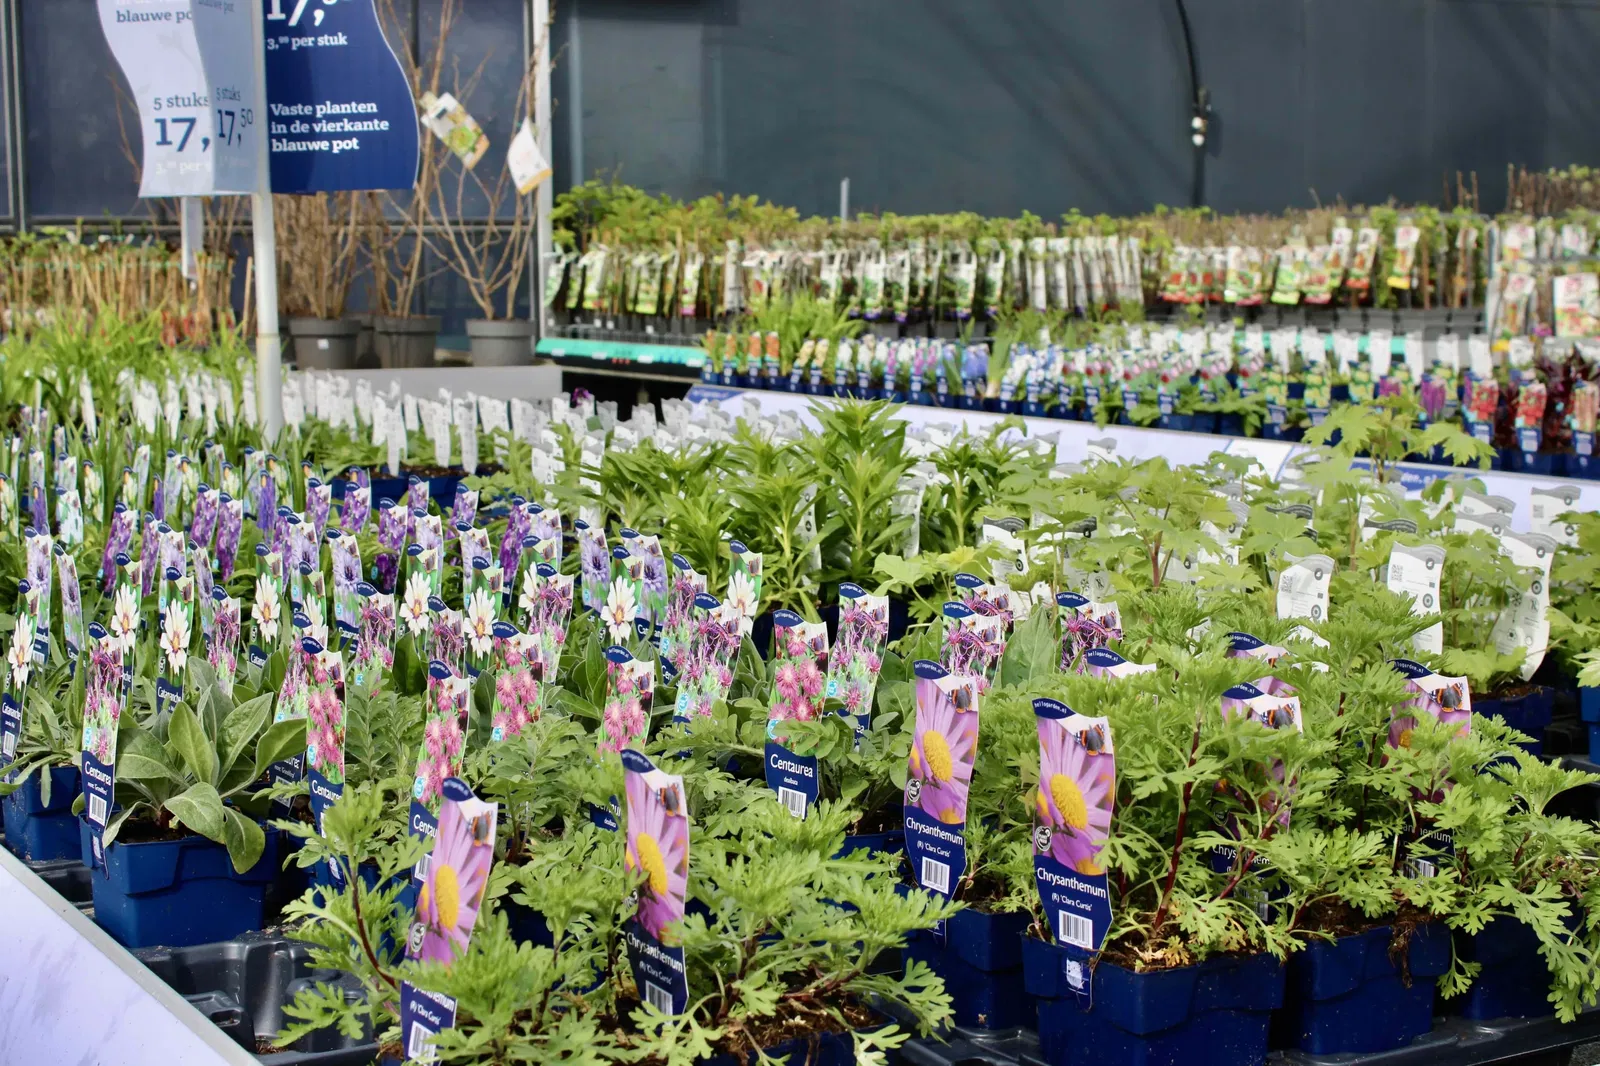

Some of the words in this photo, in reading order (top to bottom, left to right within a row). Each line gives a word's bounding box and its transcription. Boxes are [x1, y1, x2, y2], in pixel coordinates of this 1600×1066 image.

[116, 10, 172, 23] blauwe
[291, 35, 314, 50] per
[317, 32, 348, 46] stuk
[153, 97, 162, 110] 5
[166, 92, 209, 108] stuks
[270, 103, 312, 116] Vaste
[316, 100, 378, 118] planten
[271, 121, 287, 134] in
[290, 120, 310, 133] de
[312, 118, 389, 133] vierkante
[271, 138, 330, 152] blauwe
[332, 137, 360, 154] pot
[1088, 651, 1119, 662] hellogarden.nl
[914, 663, 943, 674] hellogarden.nl
[1034, 702, 1067, 714] hellogarden.nl
[84, 761, 112, 786] Centaurea
[770, 754, 813, 778] Centaurea
[413, 814, 438, 838] Centau
[906, 817, 963, 845] Chrysanthemum
[1037, 867, 1106, 899] Chrysanthemum
[1052, 892, 1060, 903] (R)
[1060, 895, 1075, 906] 'Clara
[1076, 900, 1093, 912] Curtis'
[627, 932, 683, 973] Chrysanthemum
